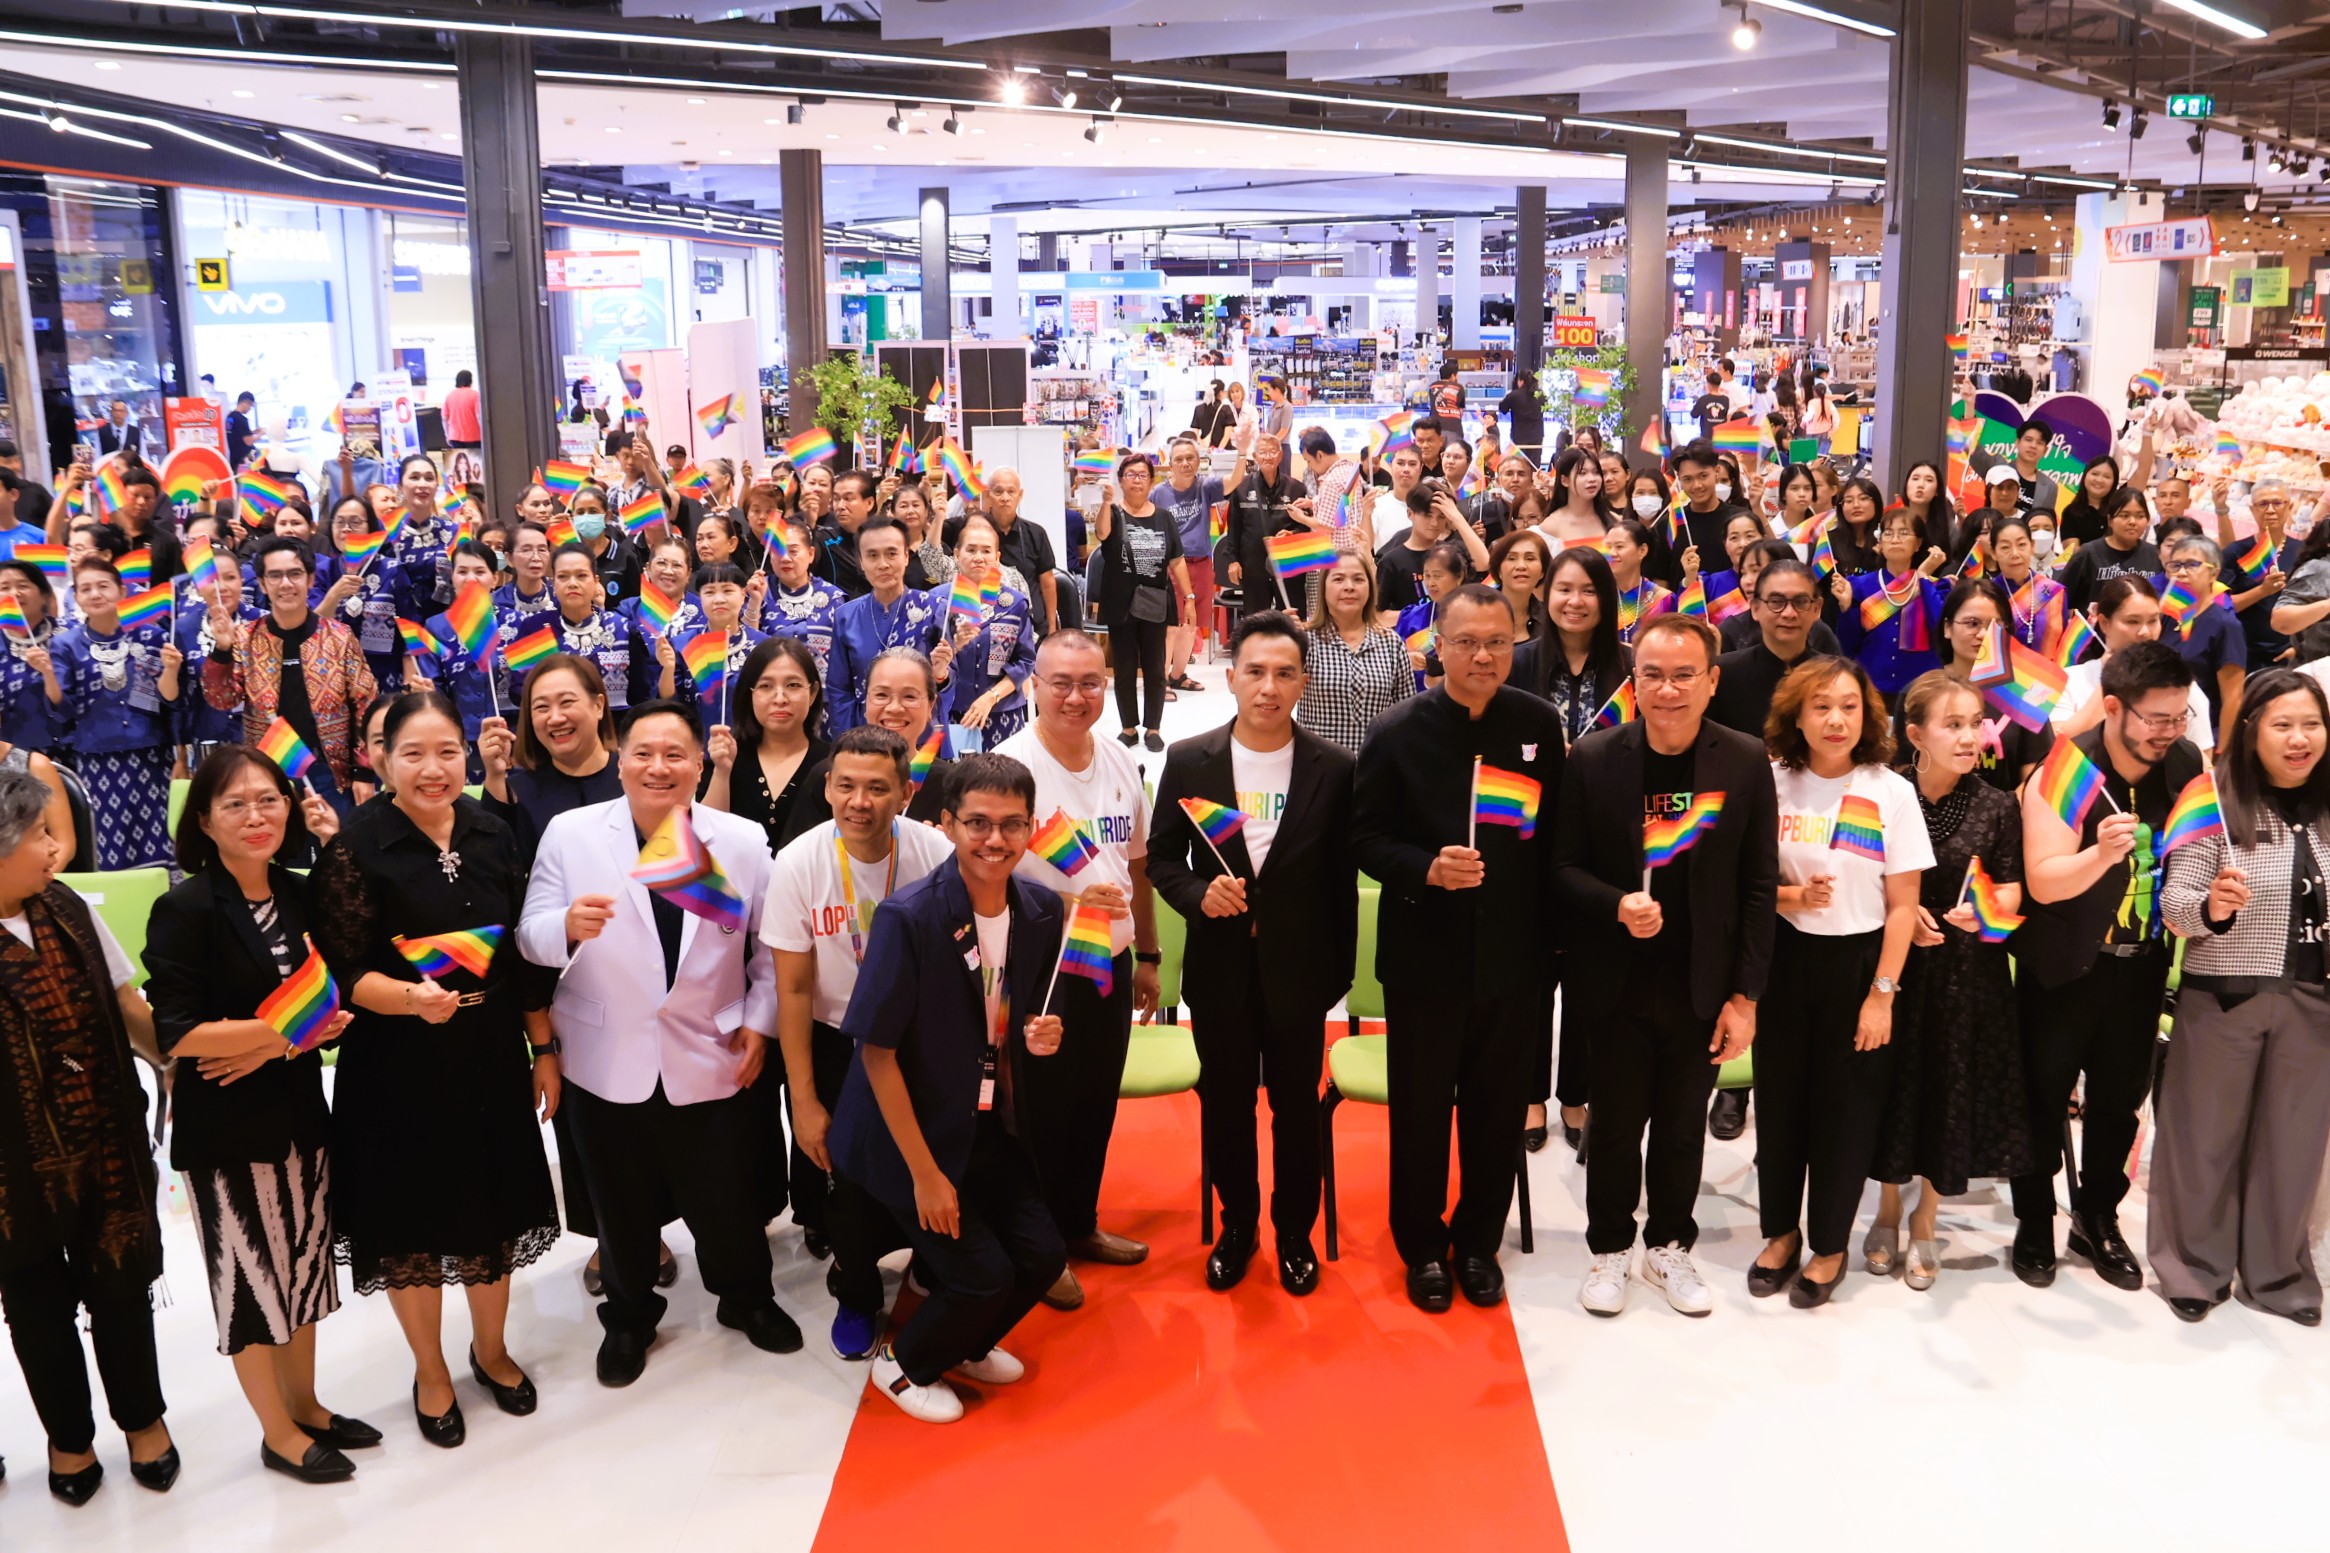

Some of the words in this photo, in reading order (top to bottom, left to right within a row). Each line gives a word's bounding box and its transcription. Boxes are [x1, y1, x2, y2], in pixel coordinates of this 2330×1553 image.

[1557, 327, 1594, 345] 100
[2262, 350, 2300, 358] WENGER
[1097, 815, 1132, 844] PRIDE
[1778, 814, 1832, 845] PBURI
